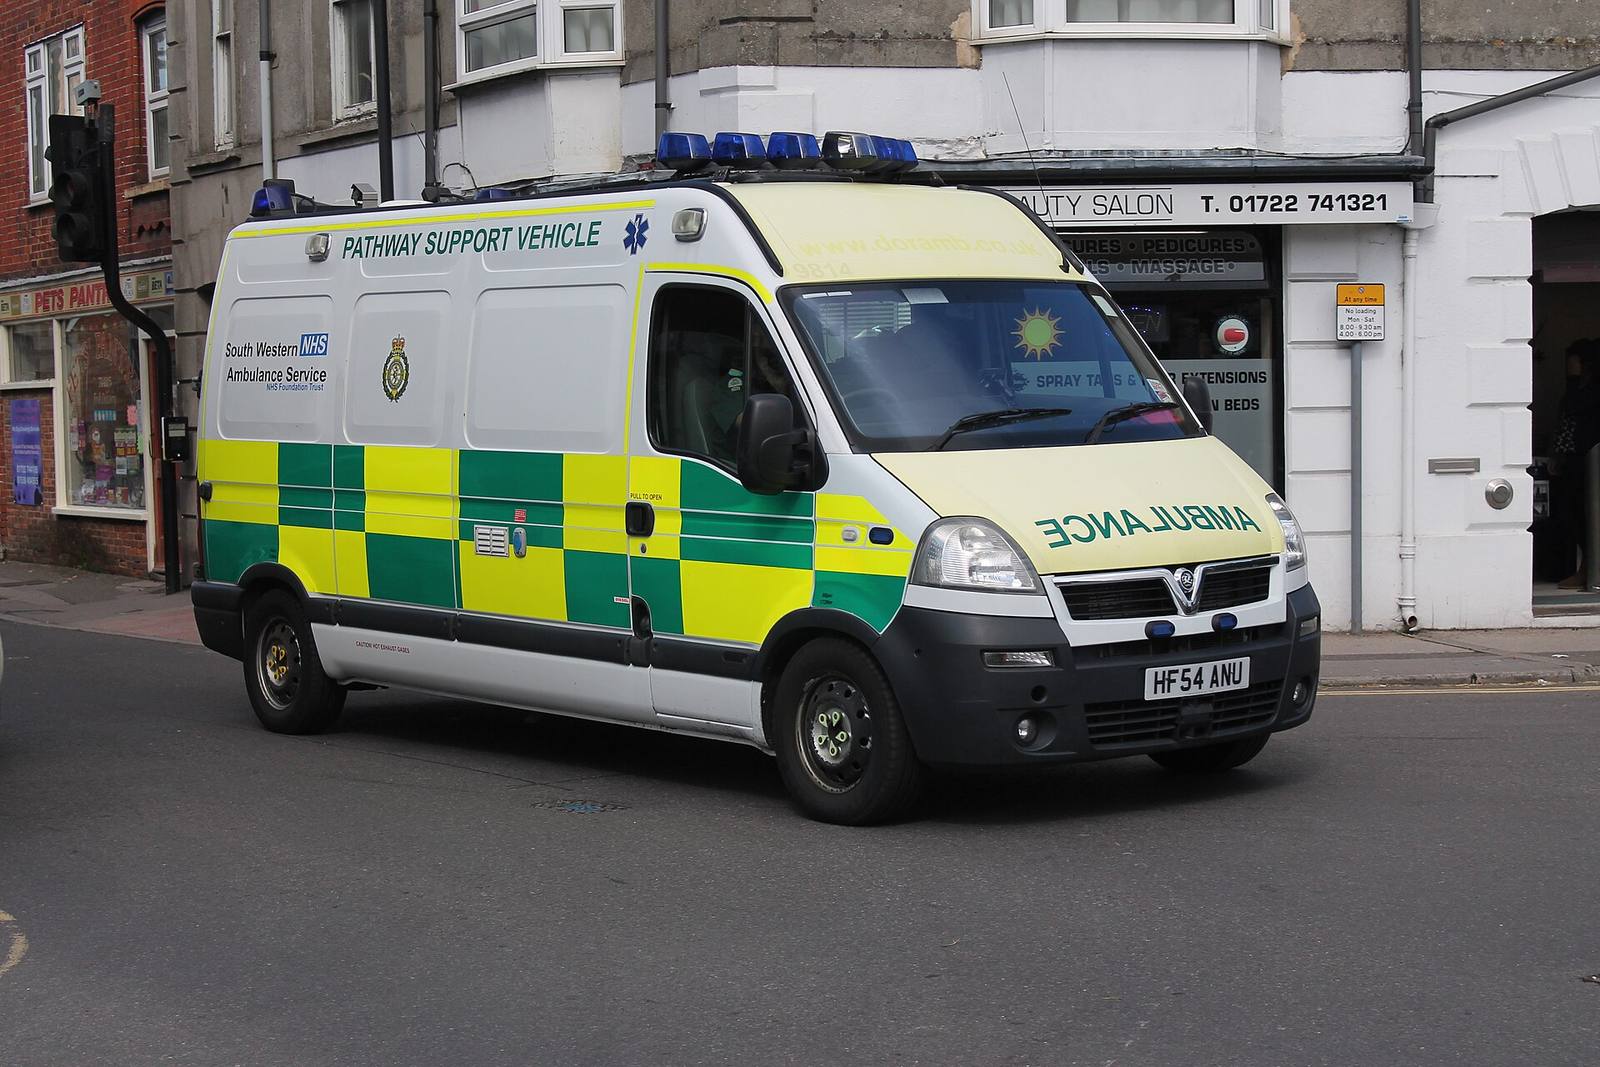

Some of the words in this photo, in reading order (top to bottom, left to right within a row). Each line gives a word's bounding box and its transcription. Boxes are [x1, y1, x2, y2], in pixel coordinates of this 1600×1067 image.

[1093, 193, 1173, 216] SALON
[1201, 195, 1220, 213] T.
[1229, 194, 1298, 213] 01722
[1308, 193, 1388, 211] 741321
[342, 232, 423, 259] PATHWAY
[425, 226, 513, 255] SUPPORT
[518, 221, 602, 250] VEHICLE
[1143, 239, 1246, 253] PEDICURES
[1131, 258, 1225, 275] MASSAGE
[35, 289, 64, 313] PETS
[225, 342, 253, 358] South
[256, 342, 298, 357] Western
[301, 334, 328, 355] NHS
[226, 366, 283, 382] Ambulance
[286, 366, 327, 382] Service
[1036, 374, 1082, 388] SPRAY
[1086, 374, 1122, 387] TAS
[266, 383, 278, 391] NHS
[279, 383, 308, 392] Foundation
[309, 383, 324, 391] Trust
[1224, 398, 1260, 411] BEDS
[649, 493, 662, 501] OPEN
[1153, 666, 1203, 695] HF54
[1210, 661, 1243, 689] ANU
